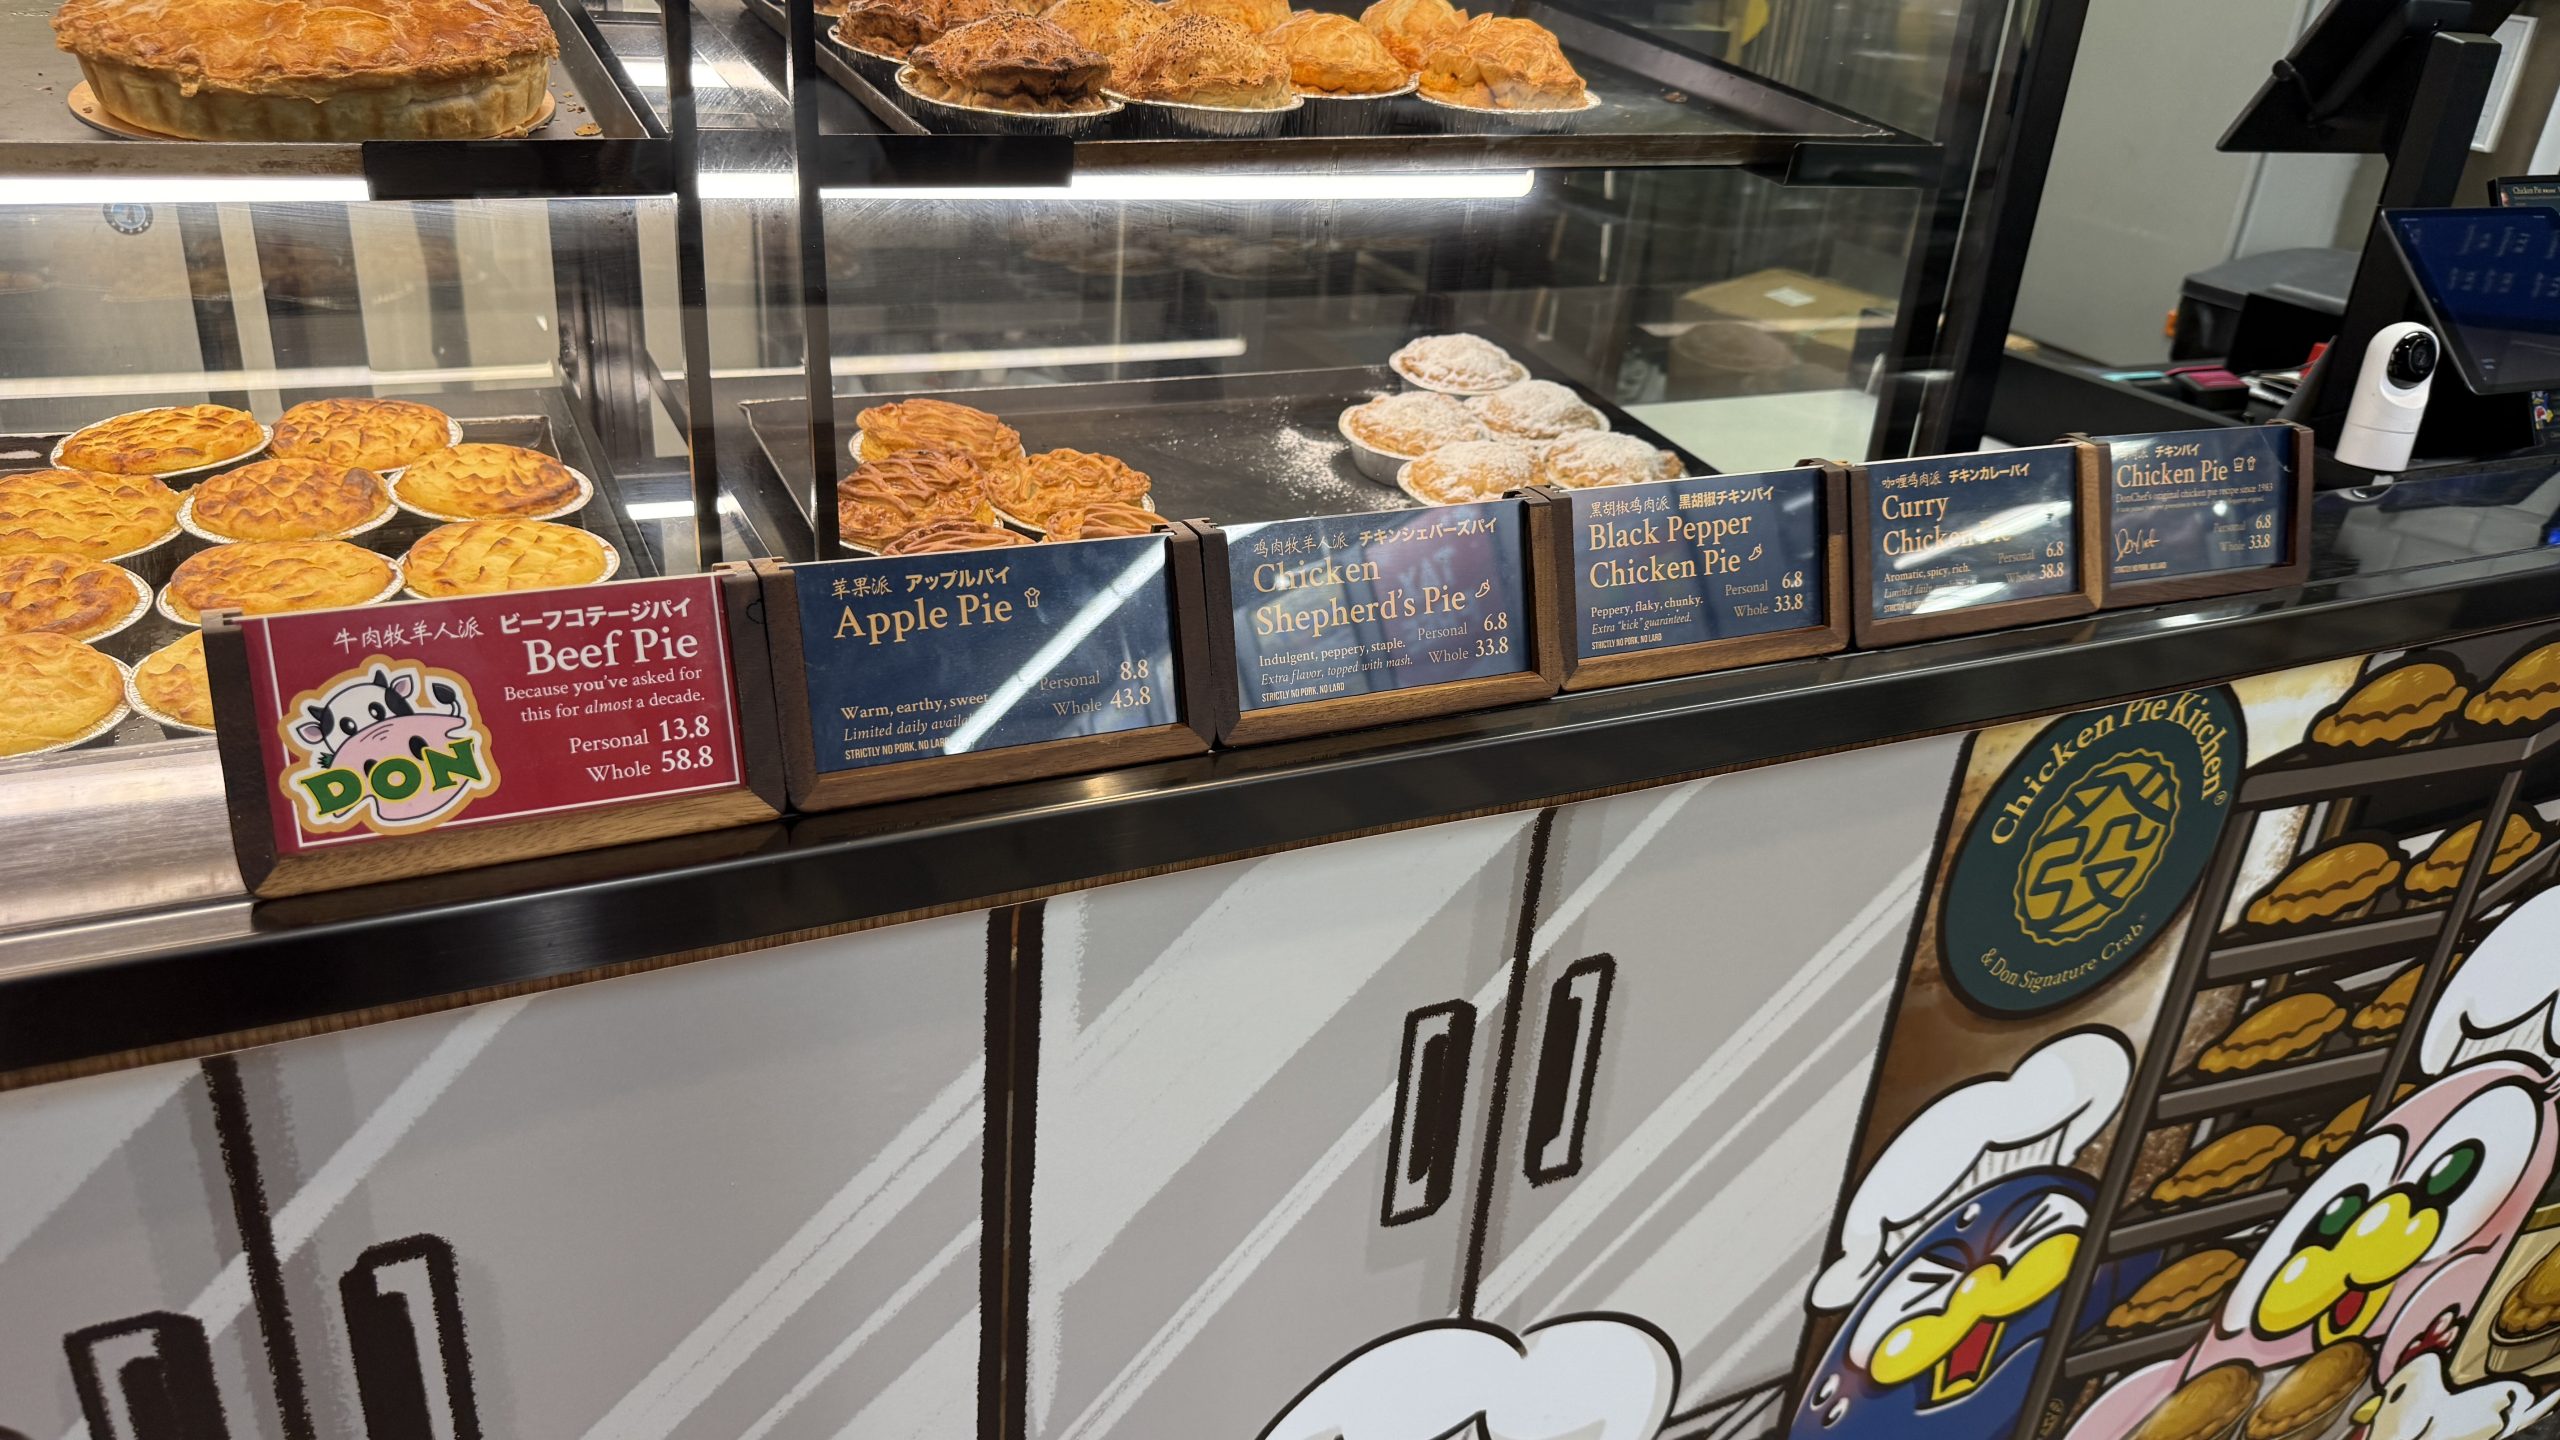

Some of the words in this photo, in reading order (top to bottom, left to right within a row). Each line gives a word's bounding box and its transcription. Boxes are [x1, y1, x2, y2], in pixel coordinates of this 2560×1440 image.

[1949, 463, 2031, 484] チキンカレーパイ
[2116, 462, 2195, 488] Chicken
[2200, 459, 2229, 482] Pie
[1882, 495, 1950, 522] Curry
[2255, 514, 2272, 529] 6.8
[1253, 532, 1349, 558] 鸡肉牧羊人派
[1588, 517, 1661, 551] Black
[1666, 514, 1752, 548] Pepper
[1883, 525, 1975, 556] Chicken
[2249, 534, 2271, 550] 33.8
[2046, 541, 2064, 558] 6.8
[905, 566, 1011, 593] アップルパイ
[1253, 557, 1381, 593] Chicken
[1590, 555, 1697, 588] Chicken
[1703, 548, 1741, 577] Pie
[1883, 567, 1926, 584] Aromatic,
[1927, 566, 1950, 579] spicy,
[1951, 563, 1972, 575] rich.
[2038, 562, 2064, 580] 38.8
[831, 575, 893, 600] 苹果派
[1725, 580, 1769, 596] Personal
[1781, 571, 1803, 589] 6.8
[500, 597, 691, 634] ビーフコテージパイ
[833, 597, 948, 646] Apple
[956, 592, 1013, 626] Pie
[1256, 588, 1416, 638] Shepherd's
[1423, 584, 1466, 615] Pie
[1591, 605, 1633, 619] Peppery,
[1635, 600, 1663, 613] flaky,
[1664, 595, 1704, 608] chunky.
[1734, 604, 1769, 618] Whole
[1773, 593, 1803, 613] 33.8
[333, 616, 485, 655] 牛肉牧羊人派
[1418, 622, 1467, 641] Personal
[1484, 612, 1508, 631] 6.8
[1592, 623, 1615, 635] Extra
[1644, 612, 1693, 631] guaranteed.
[522, 629, 623, 675] Beef
[631, 626, 698, 663] Pie
[1259, 651, 1318, 667] Indulgent,
[1321, 644, 1369, 662] peppery,
[1371, 637, 1406, 653] staple.
[1428, 648, 1469, 663] Whole
[1475, 636, 1509, 658] 33.8
[1592, 640, 1616, 650] STRICTLY
[1616, 639, 1624, 647] NO
[1624, 636, 1639, 646] PORK.
[1640, 635, 1648, 643] NO
[1648, 633, 1662, 643] LARD
[504, 684, 569, 701] Because
[573, 675, 628, 696] you've
[632, 668, 675, 686] asked
[679, 666, 702, 681] for
[1040, 670, 1100, 691] Personal
[1120, 659, 1149, 681] 8.8
[1261, 673, 1289, 686] Extra
[1290, 667, 1324, 685] flavor,
[1327, 661, 1358, 678] topped
[1361, 658, 1383, 671] with
[1386, 653, 1413, 668] mash.
[520, 707, 551, 722] this
[555, 704, 580, 719] for
[585, 698, 633, 715] almost
[636, 698, 645, 708] a
[649, 689, 705, 707] decade.
[1052, 698, 1102, 716] Whole
[1110, 686, 1151, 709] 43.8
[1262, 689, 1289, 702] STRICTLY
[1291, 689, 1300, 698] NO
[1300, 686, 1319, 697] PORK.
[1319, 684, 1329, 694] NO
[1329, 682, 1345, 692] LARD
[840, 705, 894, 720] Warm,
[896, 697, 947, 713] earthy,
[569, 728, 650, 754] Personal
[659, 715, 710, 742] 13.8
[844, 722, 892, 742] Limited
[896, 719, 928, 736] daily
[845, 745, 881, 760] STRICTLY
[882, 744, 894, 755] NO
[894, 742, 917, 754] PORK.
[918, 741, 929, 751] NO
[930, 736, 950, 749] LARD
[299, 737, 483, 816] DON
[586, 761, 651, 782] Whole
[661, 746, 714, 772] 58.8
[1991, 713, 2116, 845] Chicken
[2120, 699, 2168, 727] Pie
[1981, 947, 1997, 967] &
[1989, 957, 2019, 986] Don
[2019, 957, 2099, 994] Signature
